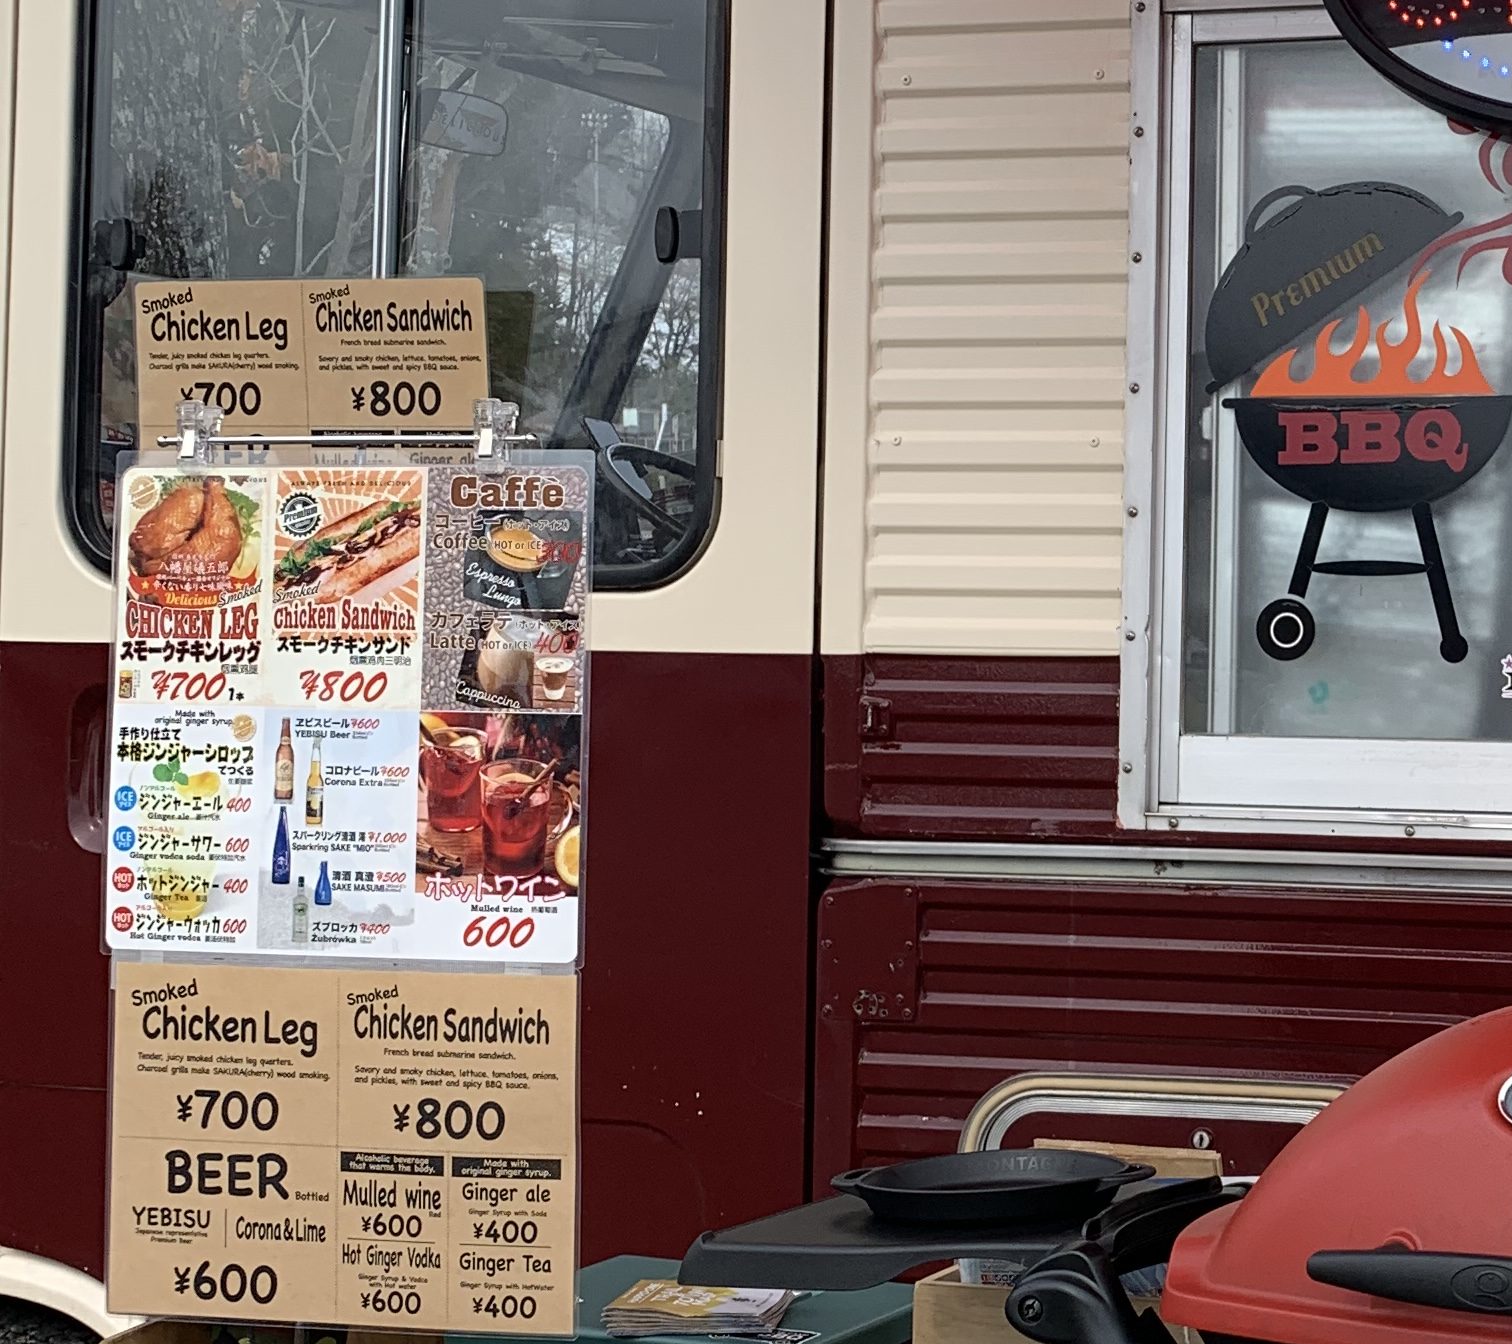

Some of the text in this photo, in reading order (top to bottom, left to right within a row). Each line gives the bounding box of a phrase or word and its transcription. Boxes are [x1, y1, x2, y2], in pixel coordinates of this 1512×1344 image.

[142, 287, 193, 315] Smoked
[309, 284, 350, 305] Smoked
[151, 310, 288, 350] Chicken Leg
[315, 300, 472, 333] Chicken Sandwich
[351, 380, 441, 417] ¥800
[1276, 408, 1469, 472] BBQ
[165, 579, 262, 608] Delicious Smoked
[273, 581, 321, 604] Smoked
[125, 600, 258, 640] CHICKEN LEG
[274, 599, 416, 631] Chicken Sandwich
[432, 611, 512, 630] カフェラテ
[120, 640, 262, 663] スモークチキンレッグ
[277, 635, 411, 655] スモークチキンサンド
[430, 633, 476, 651] Latte
[295, 730, 350, 740] YEBISU Beer
[324, 777, 383, 787] Corona Extra
[424, 871, 567, 903] ホットワイン
[471, 904, 523, 914] Mulled wine
[463, 915, 535, 949] 600
[131, 978, 198, 1007] Smoked
[347, 985, 399, 1006] Smoked
[142, 1004, 318, 1058] Chicken Leg
[354, 1003, 550, 1045] Chicken Sandwich
[176, 1089, 279, 1131] ¥700
[393, 1097, 506, 1141] ¥800
[164, 1149, 329, 1202] BEER Bottled
[343, 1179, 442, 1210] Mulled wine
[462, 1182, 551, 1207] Ginger ale
[132, 1206, 326, 1243] YEBISU Corona&Lime
[361, 1213, 422, 1238] ¥600
[472, 1220, 538, 1244] ¥400
[342, 1243, 441, 1273] Hot Ginger Vodka
[459, 1252, 552, 1277] Ginger Tea
[174, 1260, 278, 1305] ¥600
[360, 1289, 421, 1315] ¥600
[472, 1295, 537, 1319] ¥400
